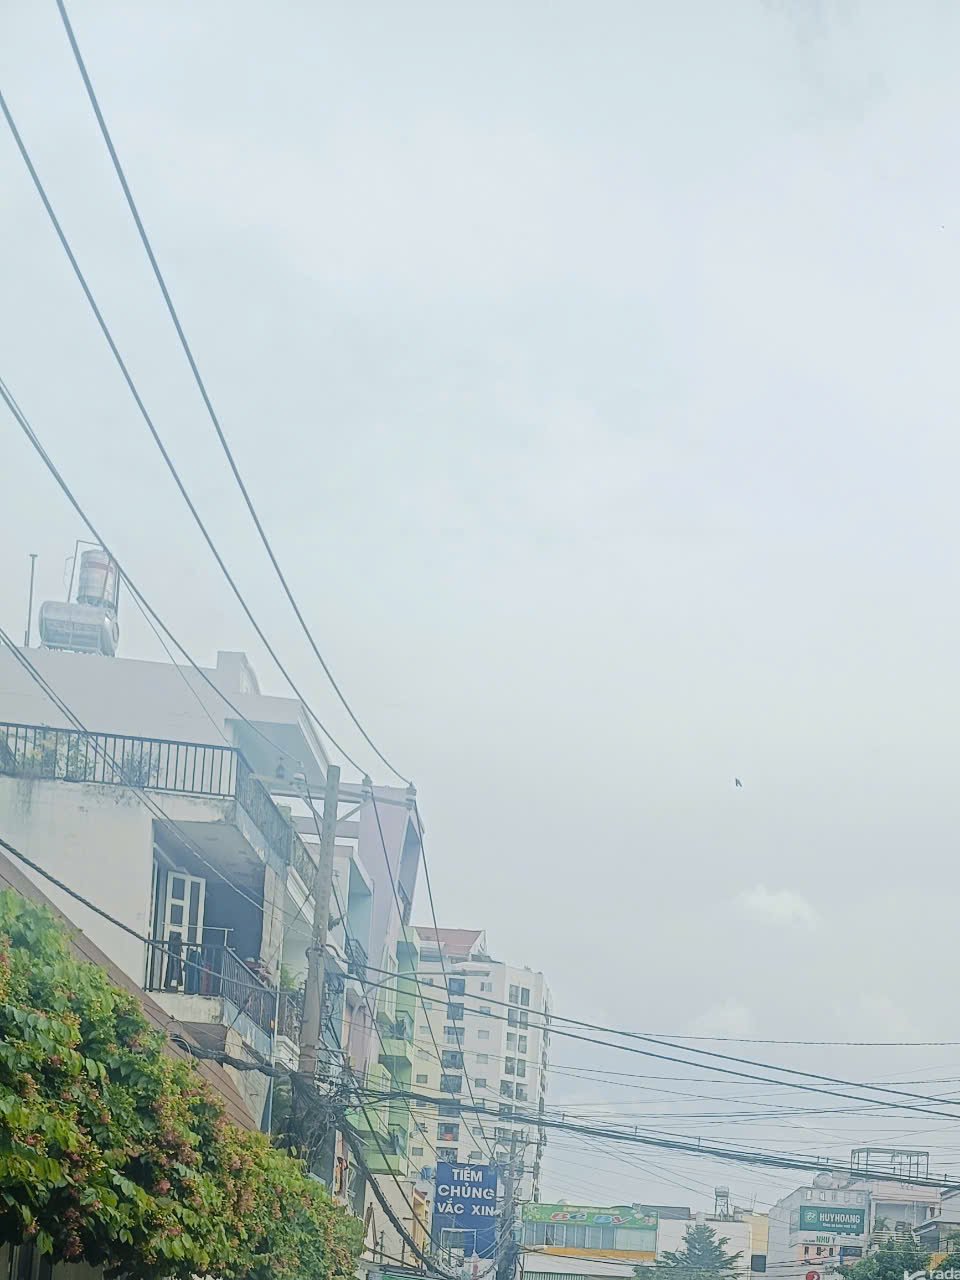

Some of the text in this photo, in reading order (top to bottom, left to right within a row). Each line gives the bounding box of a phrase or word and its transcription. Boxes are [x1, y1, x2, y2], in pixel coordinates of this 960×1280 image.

[452, 1167, 483, 1182] TIÊM
[438, 1182, 495, 1200] CHỦNG
[437, 1197, 495, 1217] VẮC XIN
